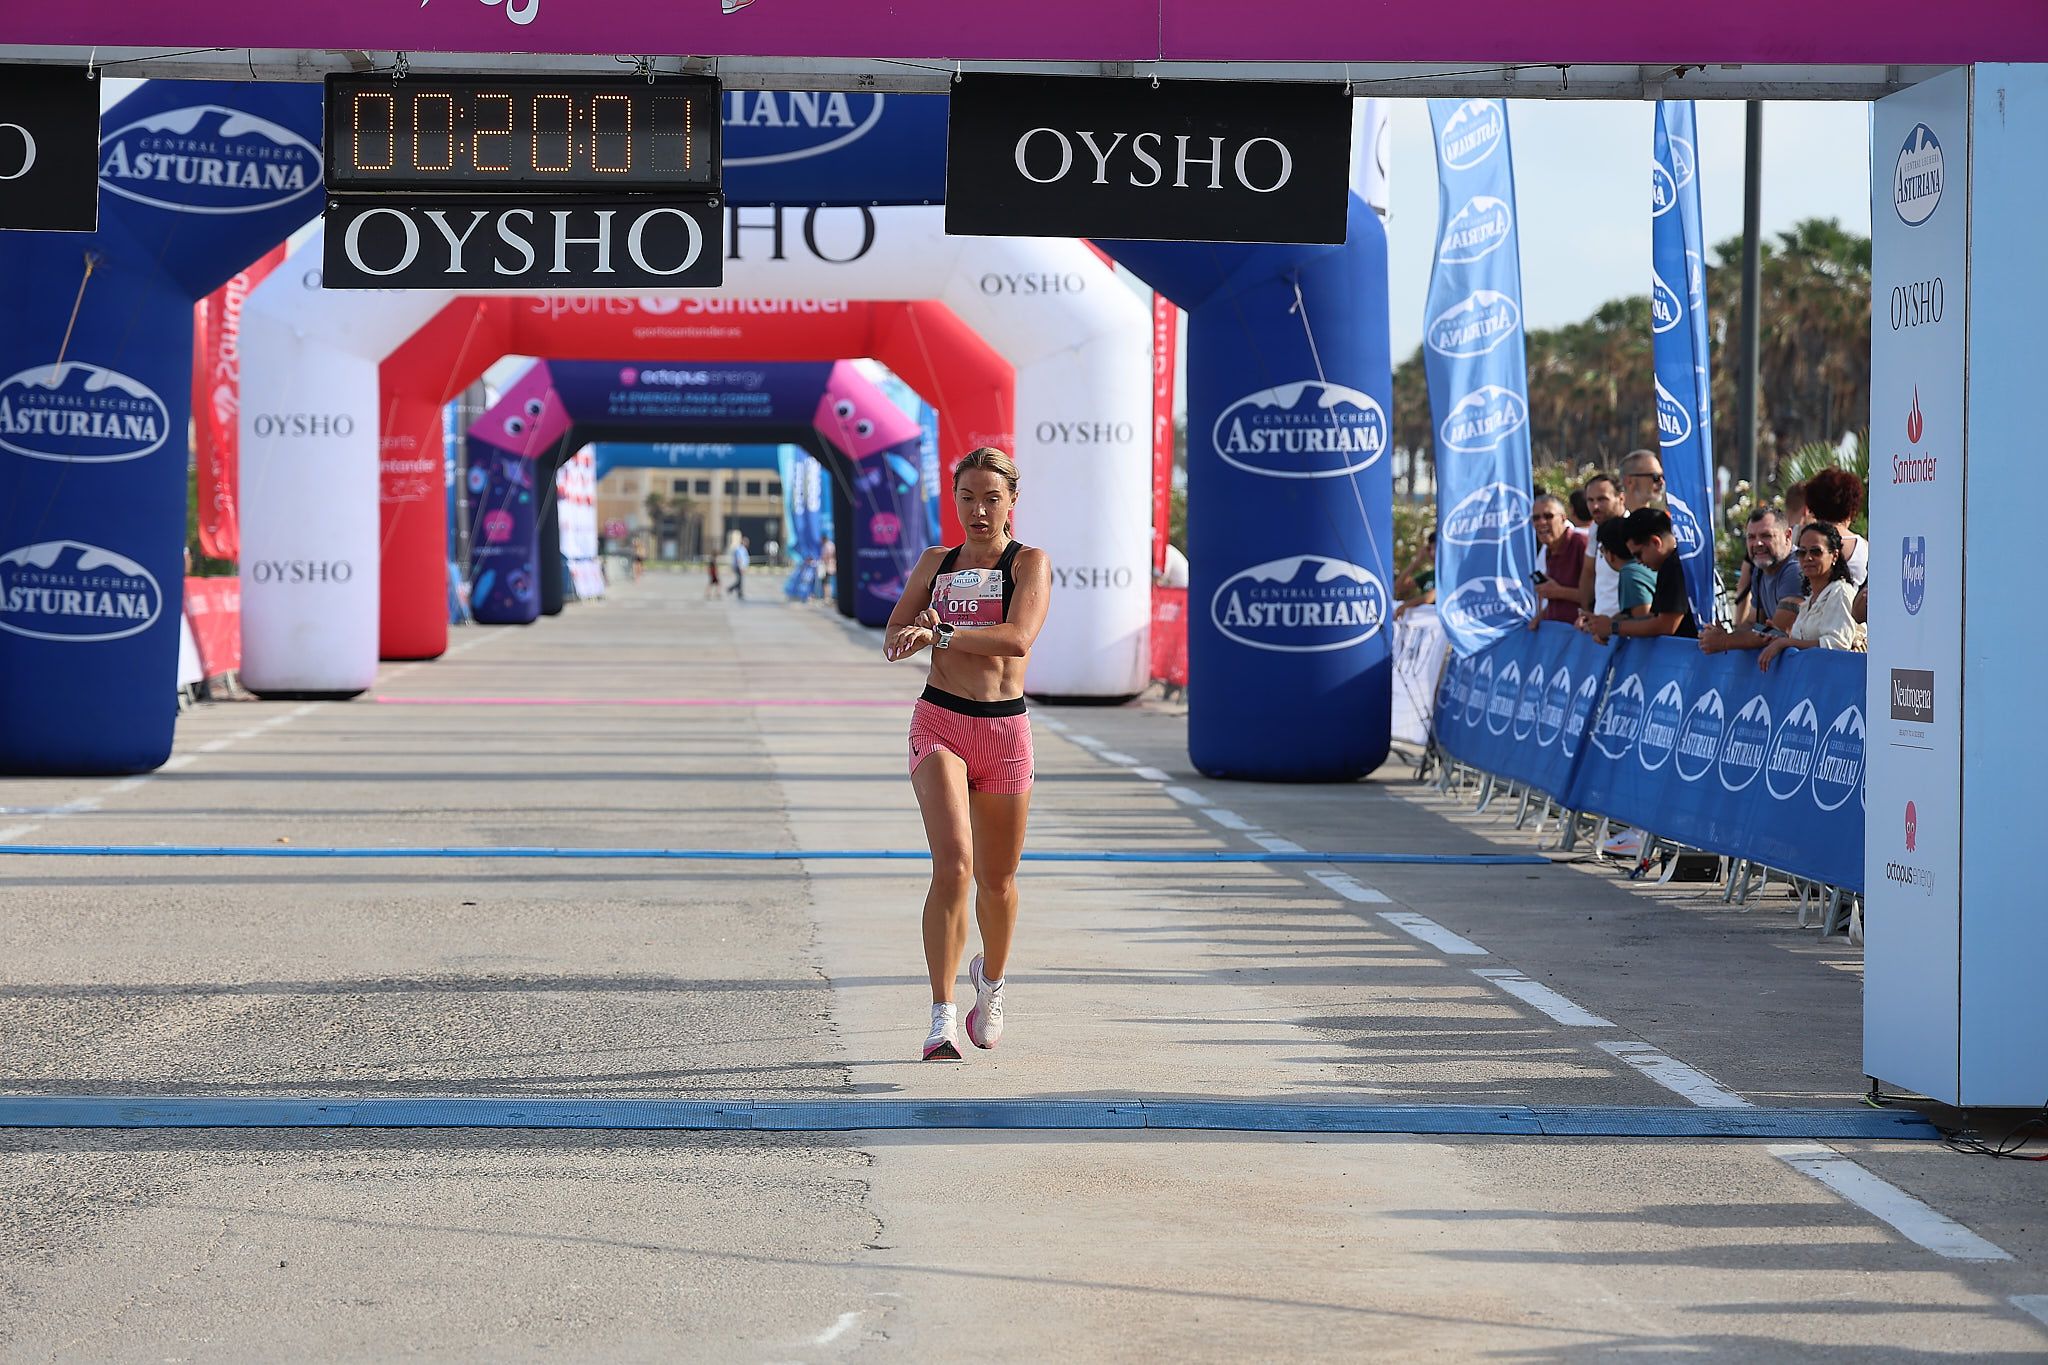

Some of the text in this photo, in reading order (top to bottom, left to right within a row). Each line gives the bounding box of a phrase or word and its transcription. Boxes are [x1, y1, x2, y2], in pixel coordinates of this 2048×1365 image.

[100, 140, 304, 190] ASTURIANA
[1015, 128, 1292, 193] OYSHO
[1897, 167, 1940, 204] ASTURIANA
[344, 207, 703, 276] OYSHO
[980, 273, 1085, 296] OYSHO
[1890, 277, 1944, 331] OYSHO
[254, 413, 354, 438] OYSHO
[1036, 421, 1133, 445] OYSHO
[1225, 417, 1380, 453] ASTURIANA
[1893, 452, 1937, 485] Santander
[252, 559, 353, 584] OYSHO
[1052, 567, 1132, 590] YSHO
[948, 600, 979, 612] 016
[1223, 590, 1378, 627] ASTURIANA
[1893, 679, 1931, 715] Neutrogena
